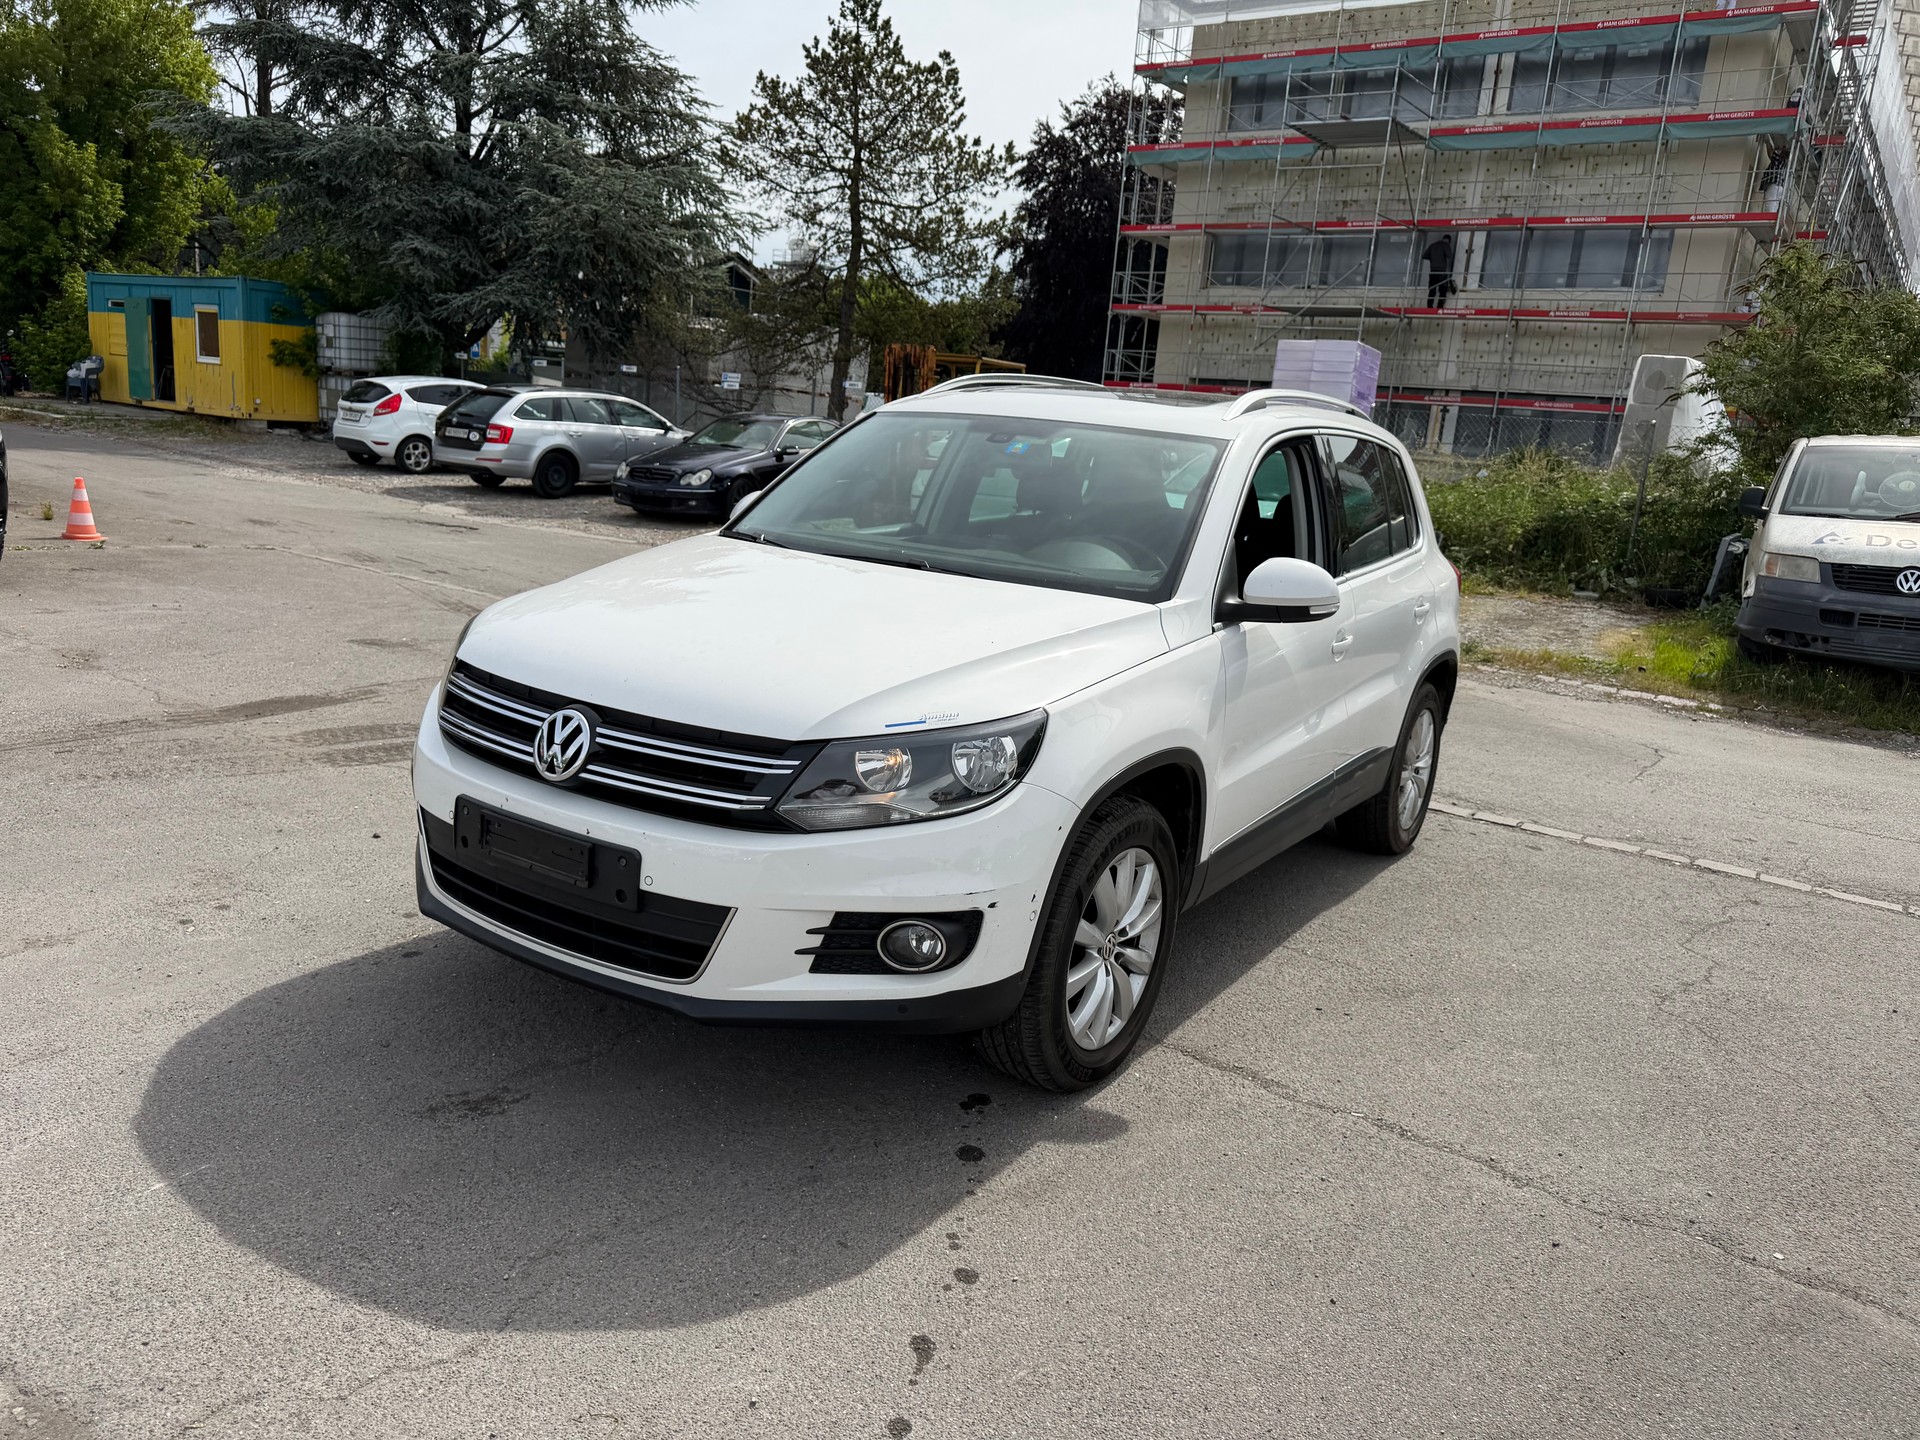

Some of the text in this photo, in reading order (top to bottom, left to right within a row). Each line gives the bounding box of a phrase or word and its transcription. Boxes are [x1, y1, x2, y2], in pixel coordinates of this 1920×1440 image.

[1750, 6, 1775, 14] GERÜSTE
[1866, 534, 1918, 549] De
[534, 708, 590, 782] VW
[1085, 819, 1145, 887] SEMPERIT
